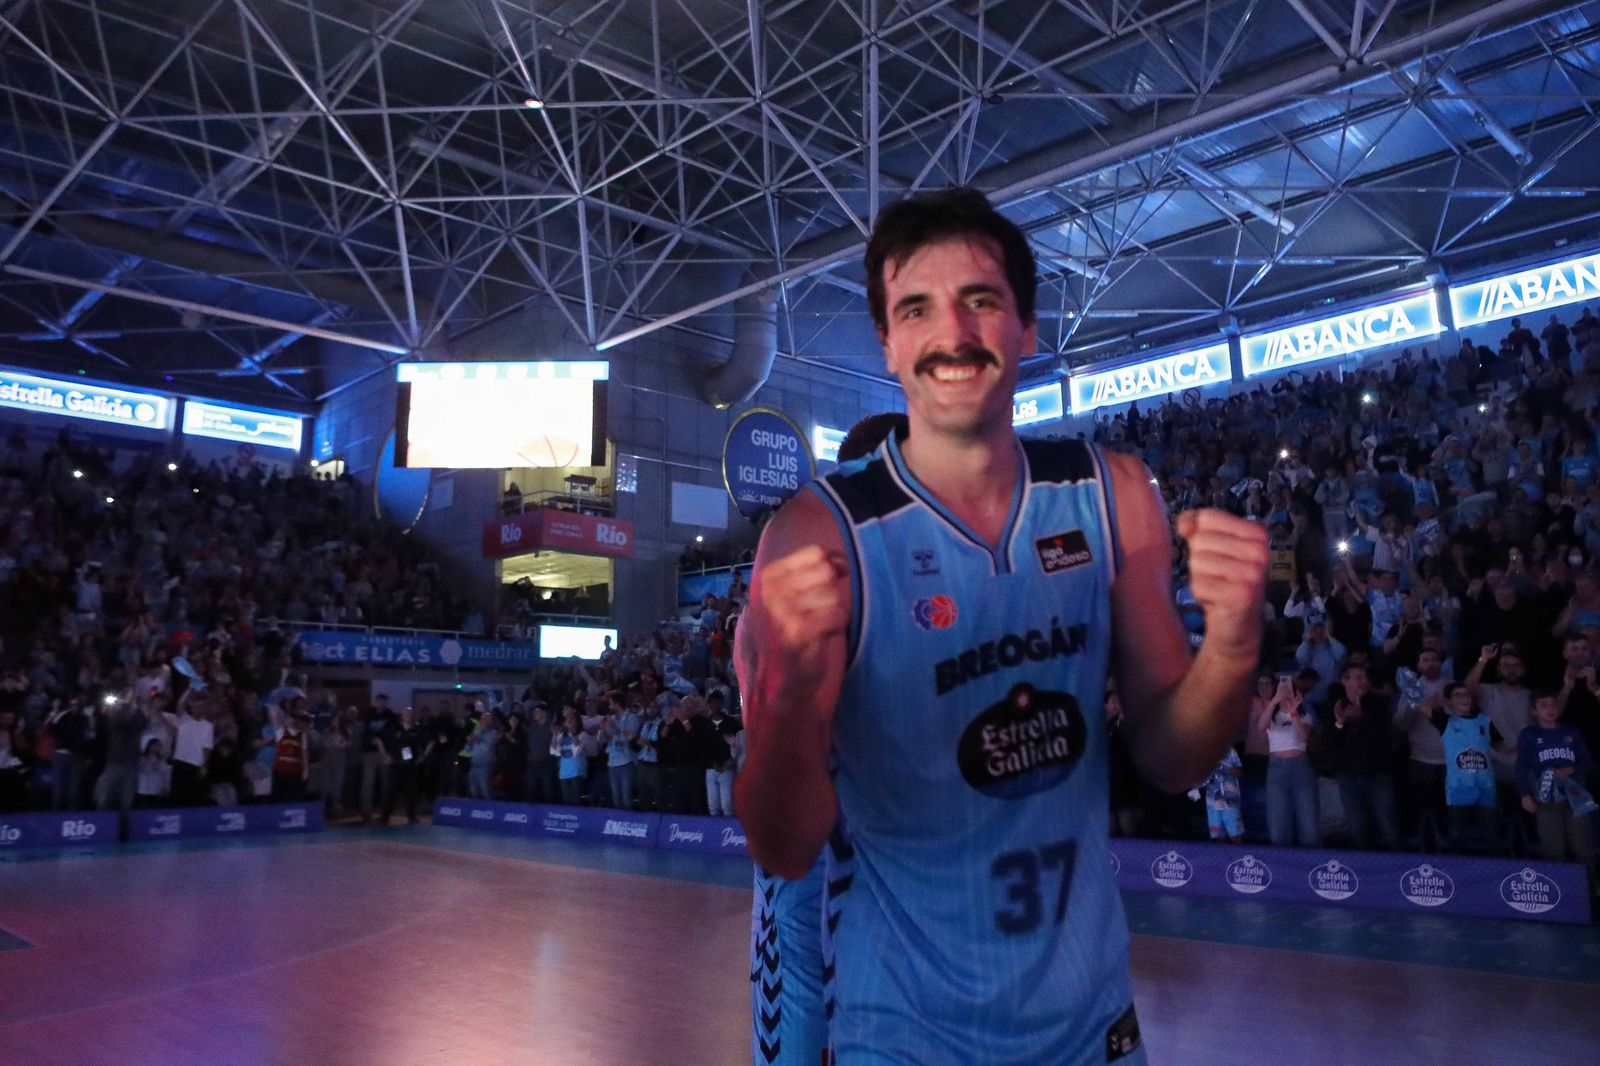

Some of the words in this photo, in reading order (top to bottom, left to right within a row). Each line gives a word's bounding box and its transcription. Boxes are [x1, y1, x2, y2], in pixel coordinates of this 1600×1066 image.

[0, 382, 64, 408] strella
[65, 390, 132, 419] Galicia
[751, 429, 798, 452] GRUPO
[768, 452, 798, 473] LUIS
[739, 465, 799, 490] IGLESIAS
[355, 646, 431, 663] ELIAS
[935, 617, 1088, 696] BREOGÁN
[982, 708, 1069, 752] Estrella
[987, 735, 1069, 777] Galicia
[1157, 861, 1186, 872] Estrella
[1232, 864, 1264, 876] Estrella
[1158, 869, 1184, 879] Galicia
[1234, 873, 1262, 884] Galicia
[1316, 870, 1349, 882] Estrella
[991, 837, 1077, 934] 37
[1318, 879, 1349, 890] Galicia
[1409, 876, 1445, 888] Estrella
[1510, 880, 1549, 893] Estrella
[1410, 885, 1443, 896] Galicia
[1512, 891, 1549, 903] Galicia
